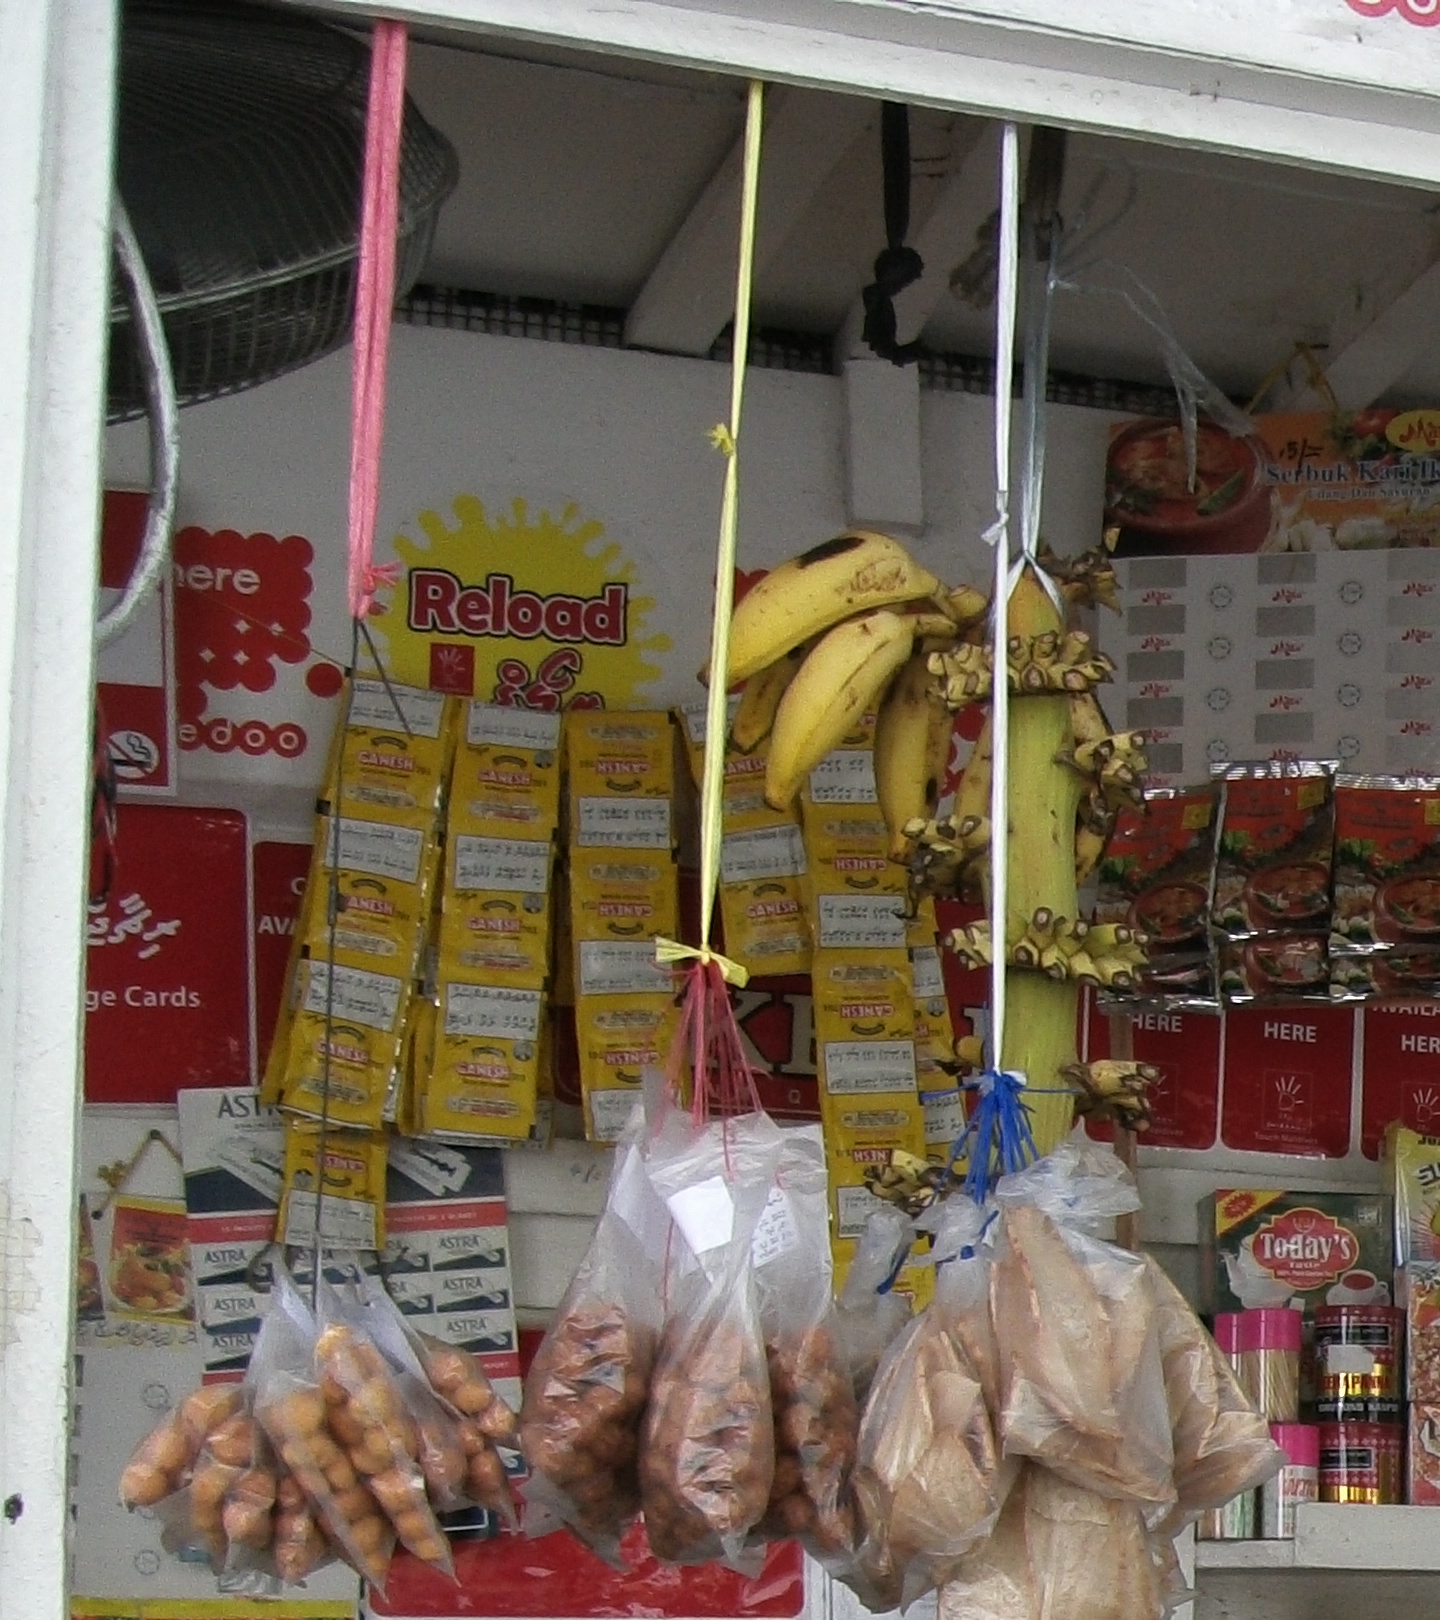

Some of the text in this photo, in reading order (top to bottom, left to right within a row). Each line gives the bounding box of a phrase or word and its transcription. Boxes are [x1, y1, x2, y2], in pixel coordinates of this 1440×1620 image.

[1266, 463, 1353, 483] Serbuk
[413, 571, 626, 644] Reload
[178, 719, 299, 750] edoo
[358, 751, 414, 771] GANESH
[597, 762, 650, 775] GANESH
[727, 759, 767, 774] ANESH
[477, 770, 531, 786] GANESH
[836, 857, 886, 871] GANESH
[346, 896, 393, 915] ANESH
[600, 904, 652, 917] GANESH
[746, 901, 799, 918] GANESH
[467, 917, 520, 932] GANESH
[124, 985, 201, 1008] Cards
[841, 1004, 896, 1018] GANESH
[1264, 1021, 1317, 1043] HERE
[456, 1063, 509, 1078] GANESH
[218, 1094, 288, 1119] AST
[853, 1150, 890, 1162] NESH
[438, 1236, 483, 1250] ASTRA
[1260, 1232, 1350, 1261] Today's
[204, 1250, 247, 1264] ASTRA
[442, 1278, 483, 1291] ASTRA
[213, 1299, 256, 1311] ASTRA
[447, 1318, 488, 1332] ASTRA
